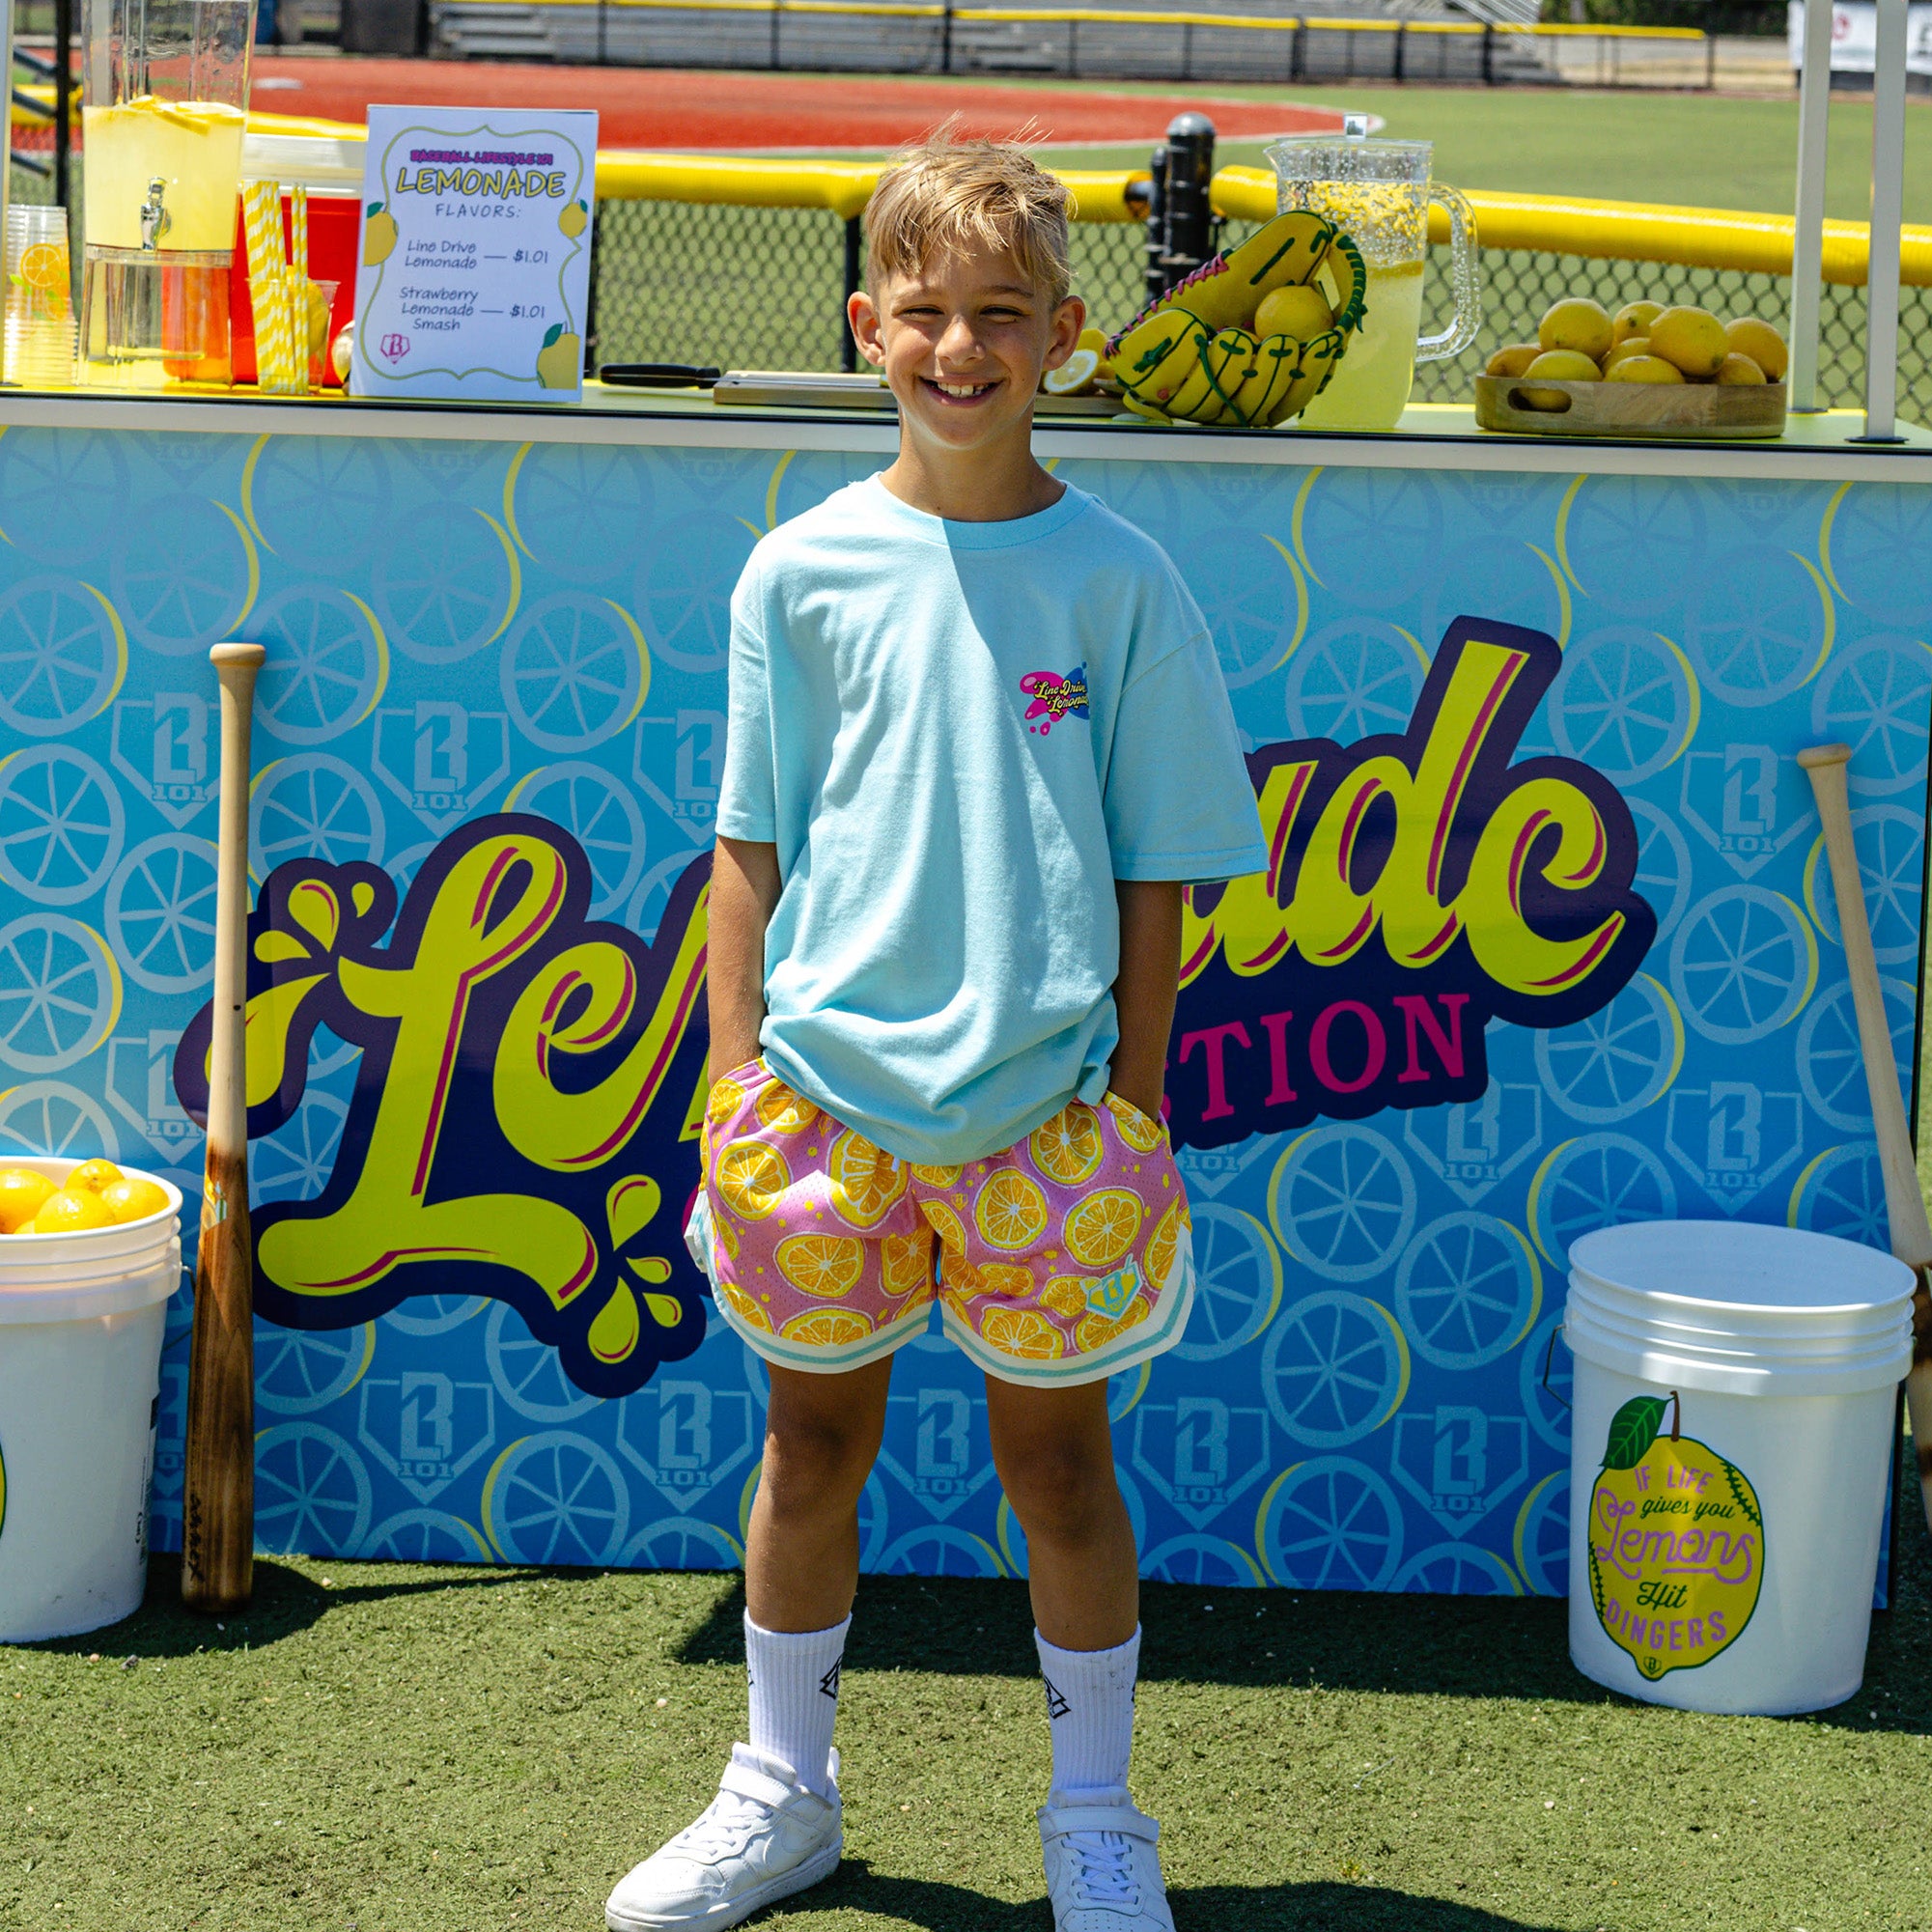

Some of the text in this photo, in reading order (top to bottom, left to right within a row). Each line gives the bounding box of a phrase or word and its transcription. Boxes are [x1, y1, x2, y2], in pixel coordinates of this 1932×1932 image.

[410, 149, 471, 164] BASEBALL
[473, 151, 536, 166] LIFESTYLE
[396, 167, 566, 200] LEMONADE
[435, 203, 520, 219] FLAVORS:
[407, 239, 477, 254] Line Drive
[405, 256, 477, 269] Lemonade
[513, 248, 548, 264] $1.01
[400, 286, 479, 304] Strawberry
[402, 302, 474, 317] Lemonade
[510, 303, 546, 319] $1.01
[413, 318, 461, 331] Smash
[1034, 681, 1059, 700] Line
[152, 785, 208, 801] 101
[412, 794, 468, 810] 101
[674, 802, 717, 818] 10
[1722, 835, 1778, 854] 101
[1706, 1172, 1762, 1189] 101
[399, 1461, 454, 1478] 101
[658, 1470, 714, 1487] 101
[1635, 1465, 1714, 1495] IF LIFE
[915, 1479, 970, 1496] 101
[1173, 1488, 1228, 1505] 101
[1432, 1496, 1487, 1512] 101
[1640, 1497, 1738, 1522] gives you
[1595, 1487, 1755, 1584] Lemons
[1637, 1582, 1689, 1611] Hit
[1606, 1598, 1727, 1651] DINGERS
